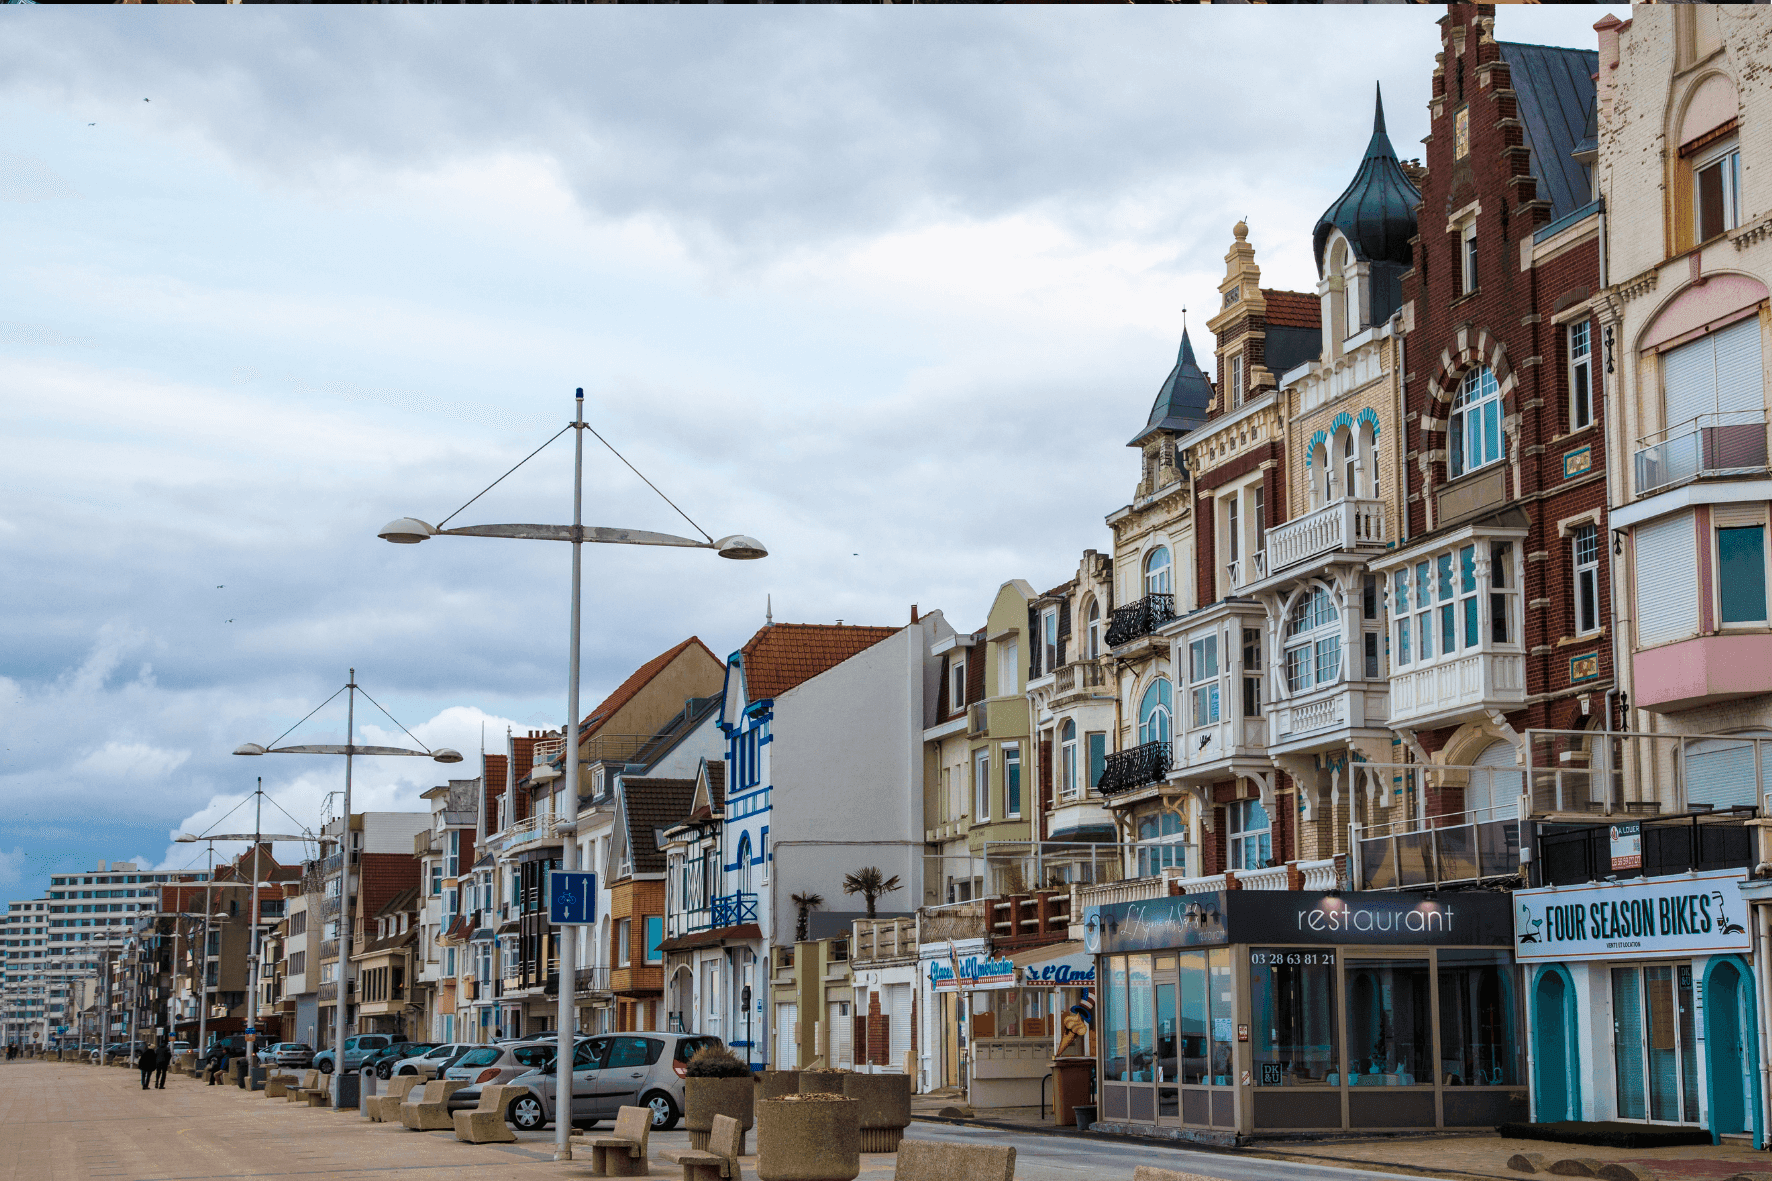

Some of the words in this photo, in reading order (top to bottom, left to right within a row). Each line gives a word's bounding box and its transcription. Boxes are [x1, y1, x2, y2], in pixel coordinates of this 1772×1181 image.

[1623, 826, 1640, 834] LOUER
[1298, 903, 1454, 932] restaurant
[1545, 903, 1587, 942] FOUR
[1589, 898, 1656, 940] SEASON
[1658, 893, 1714, 936] BIKES
[1251, 953, 1265, 964] 03
[1269, 953, 1283, 964] 28
[1287, 953, 1300, 964] 63
[1304, 953, 1317, 964] 81
[1321, 953, 1335, 964] 21
[1264, 1065, 1279, 1073] DK
[1264, 1073, 1279, 1082] &U
